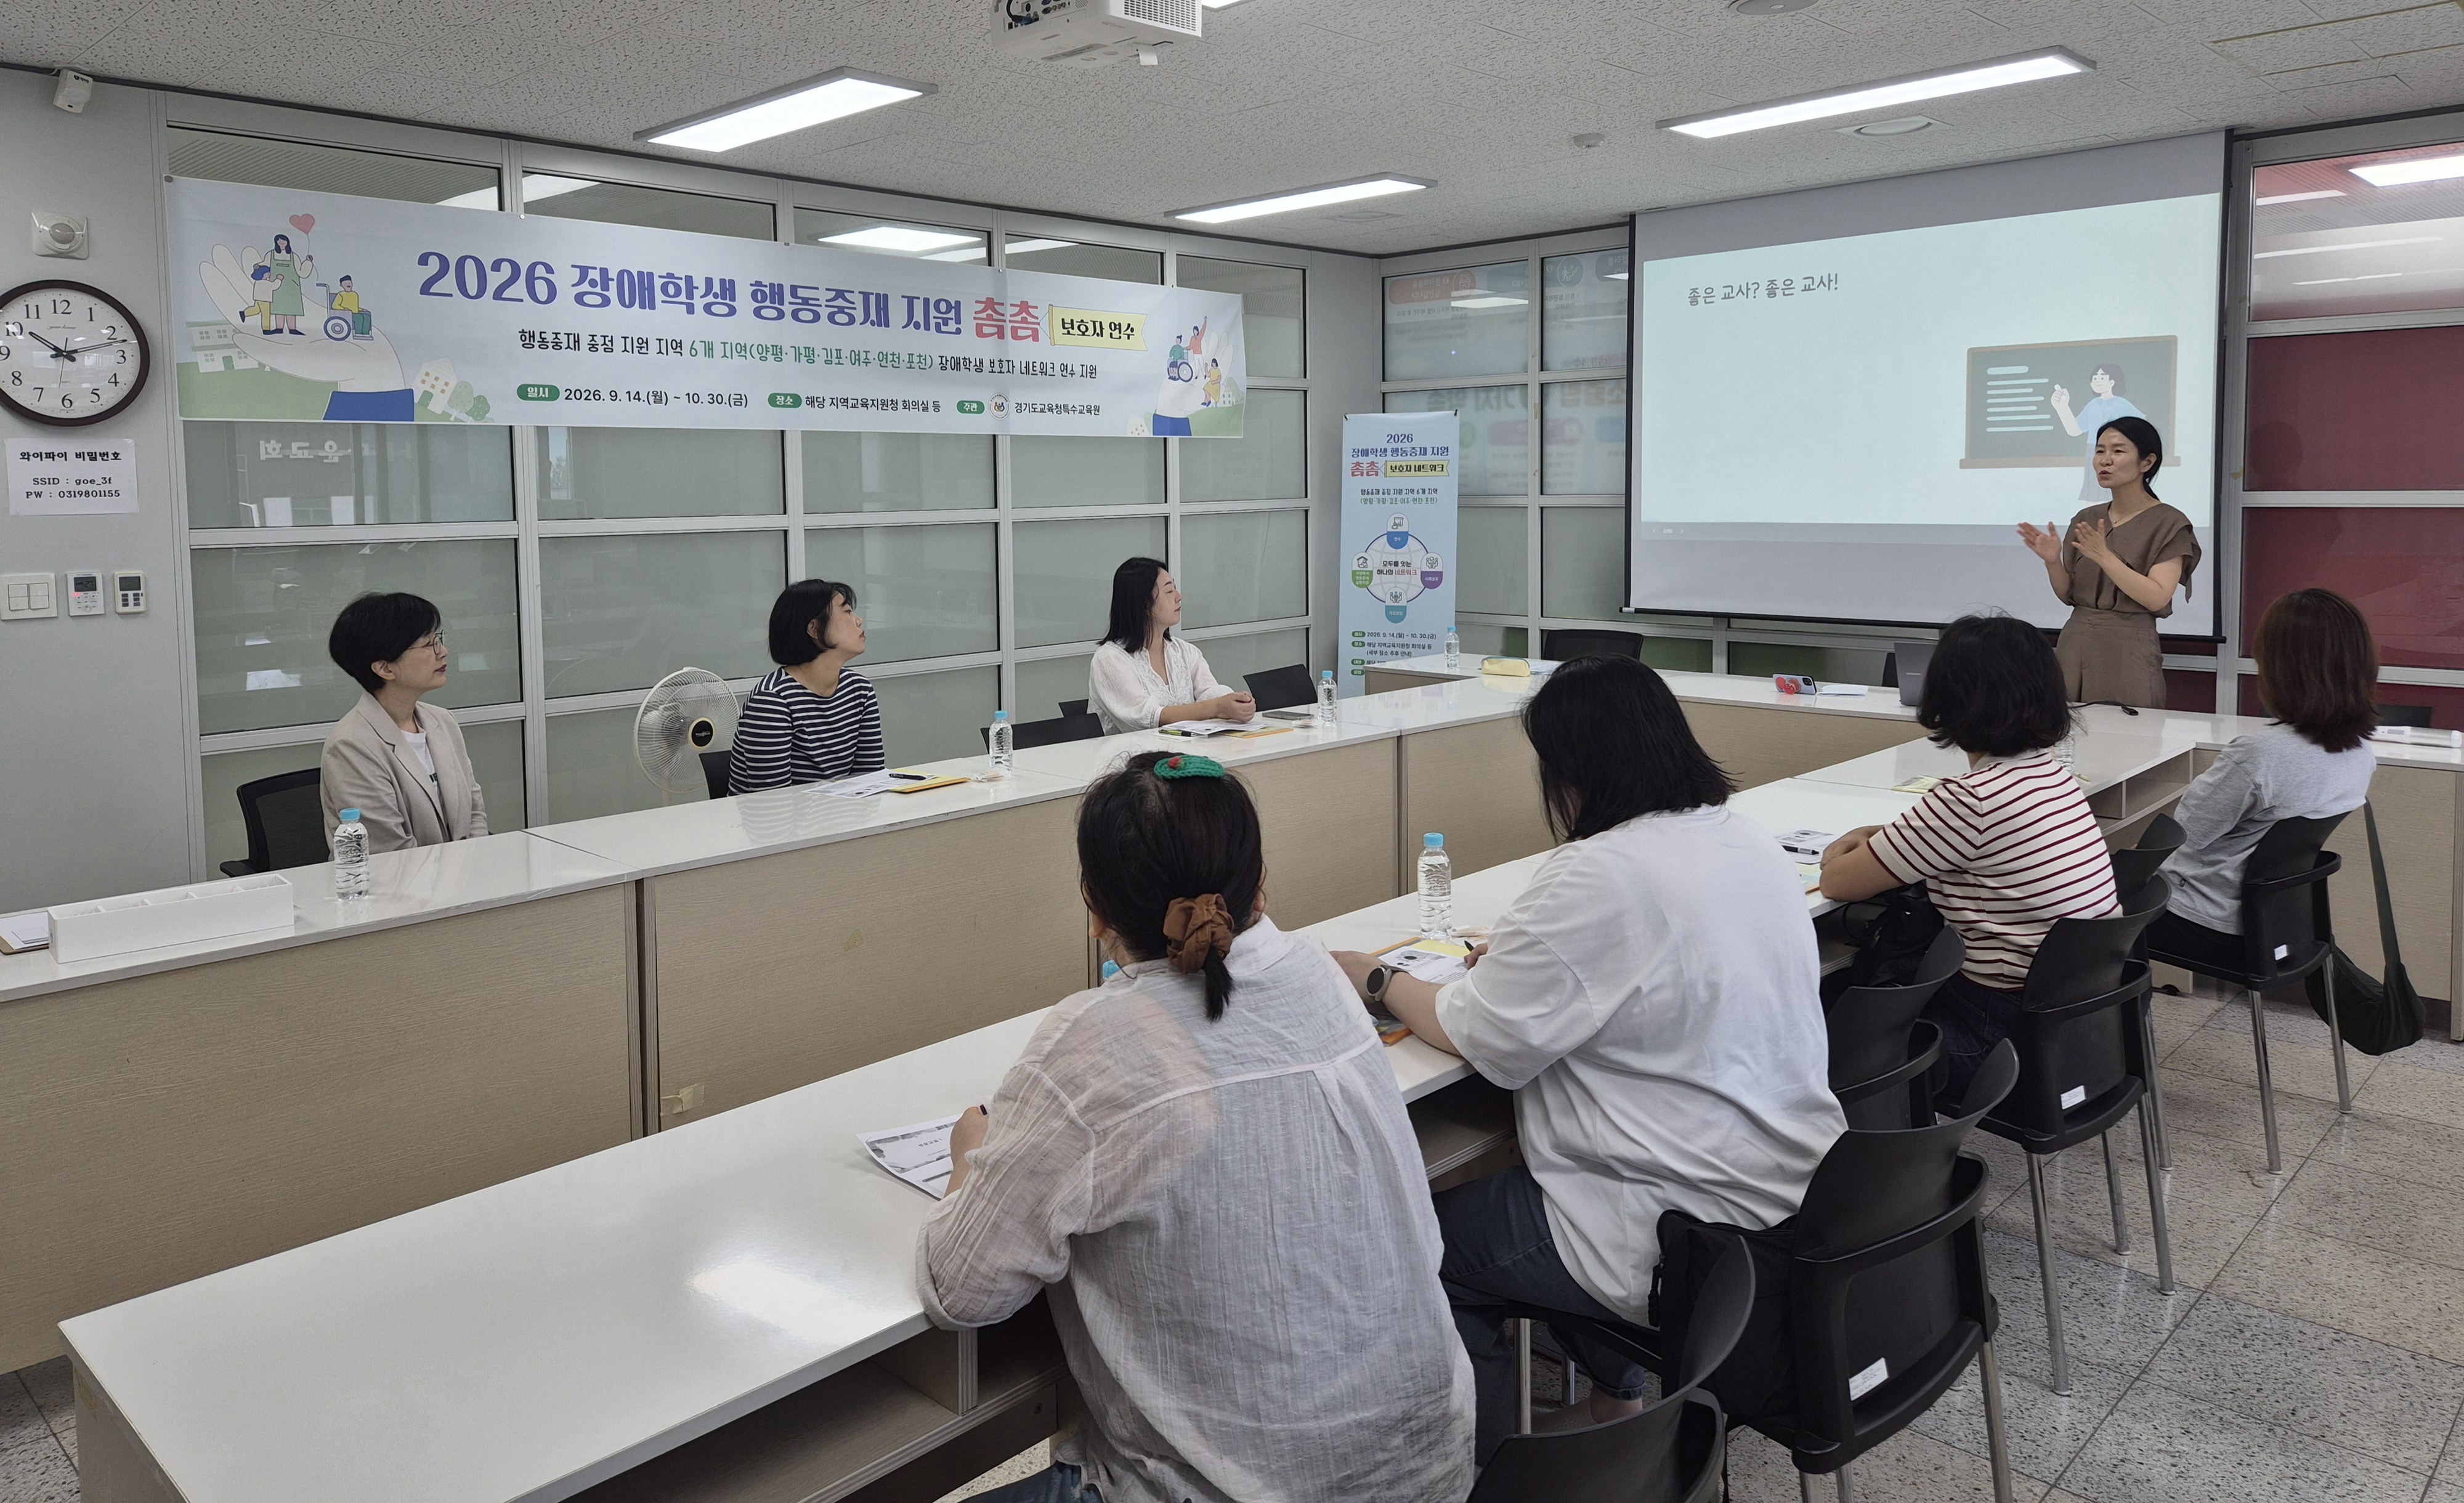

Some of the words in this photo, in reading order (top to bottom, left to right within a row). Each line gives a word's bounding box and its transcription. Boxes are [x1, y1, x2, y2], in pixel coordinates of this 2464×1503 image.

[417, 251, 557, 305] 2026
[571, 264, 737, 317] 장애학생
[750, 280, 890, 328] 행동중재
[901, 294, 962, 335] 지원
[973, 297, 1040, 342] 촘촘
[1688, 287, 1716, 306] 좋은
[1720, 282, 1760, 300] 교사?
[1765, 278, 1796, 298] 좋은
[1801, 273, 1838, 292] 교사!
[23, 304, 41, 319] 11
[51, 299, 72, 315] 12
[87, 307, 95, 322] 1
[105, 325, 118, 340] 2
[1061, 318, 1104, 338] 보호자
[1109, 321, 1135, 340] 연수
[116, 349, 126, 364] 3
[518, 328, 581, 352] 행동중재
[587, 334, 614, 353] 중점
[620, 335, 650, 355] 지원
[655, 338, 683, 357] 지역
[689, 339, 715, 359] 6개
[938, 355, 984, 373] 장애학생
[987, 357, 1015, 375] 보호자
[1019, 360, 1055, 377] 네트워크
[1060, 362, 1076, 378] 연수
[1079, 363, 1097, 379] 지원
[11, 371, 22, 386] 8
[107, 372, 120, 387] 4
[33, 387, 44, 402] 7
[90, 388, 100, 403] 5
[527, 386, 549, 399] 일시
[564, 389, 606, 402] 2026.
[609, 389, 622, 402] 9.
[626, 390, 669, 405] 14.(월)
[685, 392, 704, 404] 10.
[707, 392, 748, 408] 30.(금)
[61, 393, 73, 408] 6
[776, 395, 793, 406] 장소
[805, 395, 825, 408] 해당
[829, 396, 899, 411] 지역교육지원청
[902, 399, 929, 412] 회의실
[931, 400, 941, 413] 등
[963, 402, 978, 412] 주관
[1014, 402, 1100, 416] 경기도교육청특수교육원
[1386, 434, 1413, 444] 2026
[19, 451, 67, 461] 와이파이
[75, 451, 121, 461] 비밀번호
[1352, 447, 1387, 458] 장애학생
[1390, 447, 1427, 457] 행동중재
[1430, 446, 1449, 456] 지원
[1350, 461, 1380, 477] 촘촘
[1390, 464, 1412, 473] 보호자
[1414, 464, 1445, 472] 네트워크
[33, 477, 60, 485] SSID
[75, 477, 112, 486] goe_3f
[59, 490, 120, 498] 0319801155
